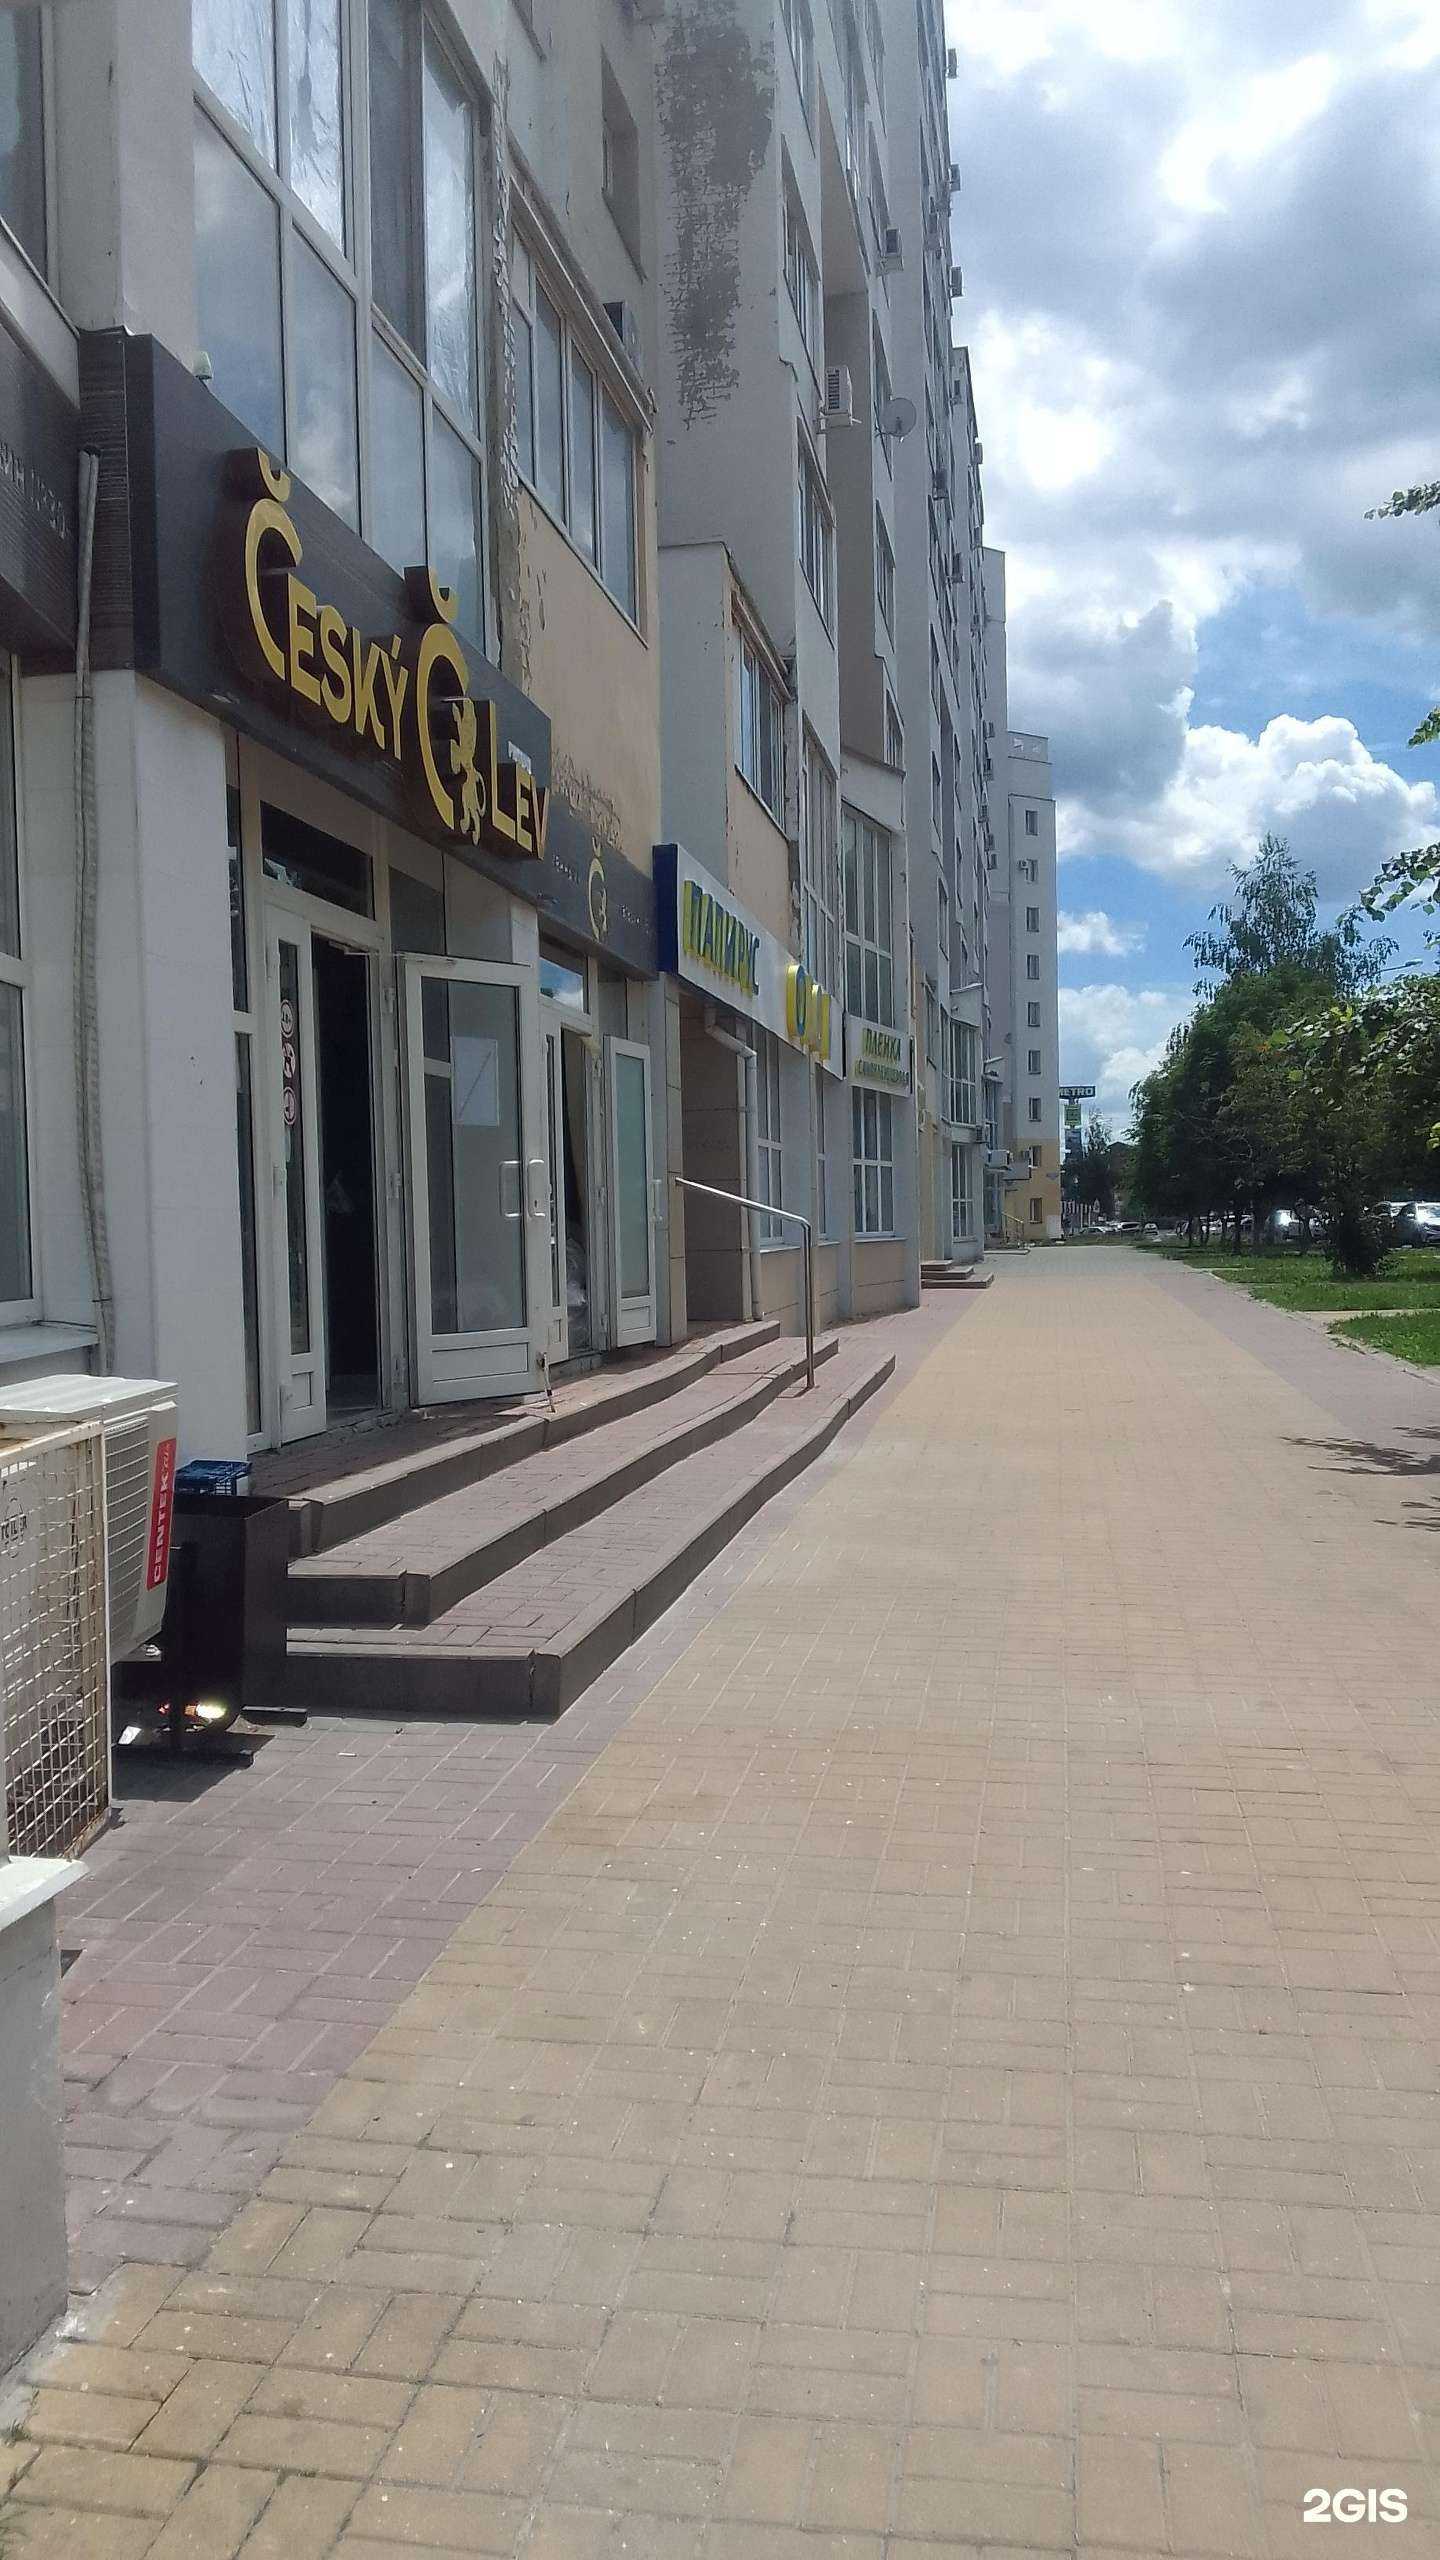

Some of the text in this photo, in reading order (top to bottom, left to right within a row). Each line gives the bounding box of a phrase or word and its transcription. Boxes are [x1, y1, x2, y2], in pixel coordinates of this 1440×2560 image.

[244, 448, 409, 761] ČESKÝ
[489, 700, 550, 861] LEV
[153, 1471, 169, 1583] CENTEK
